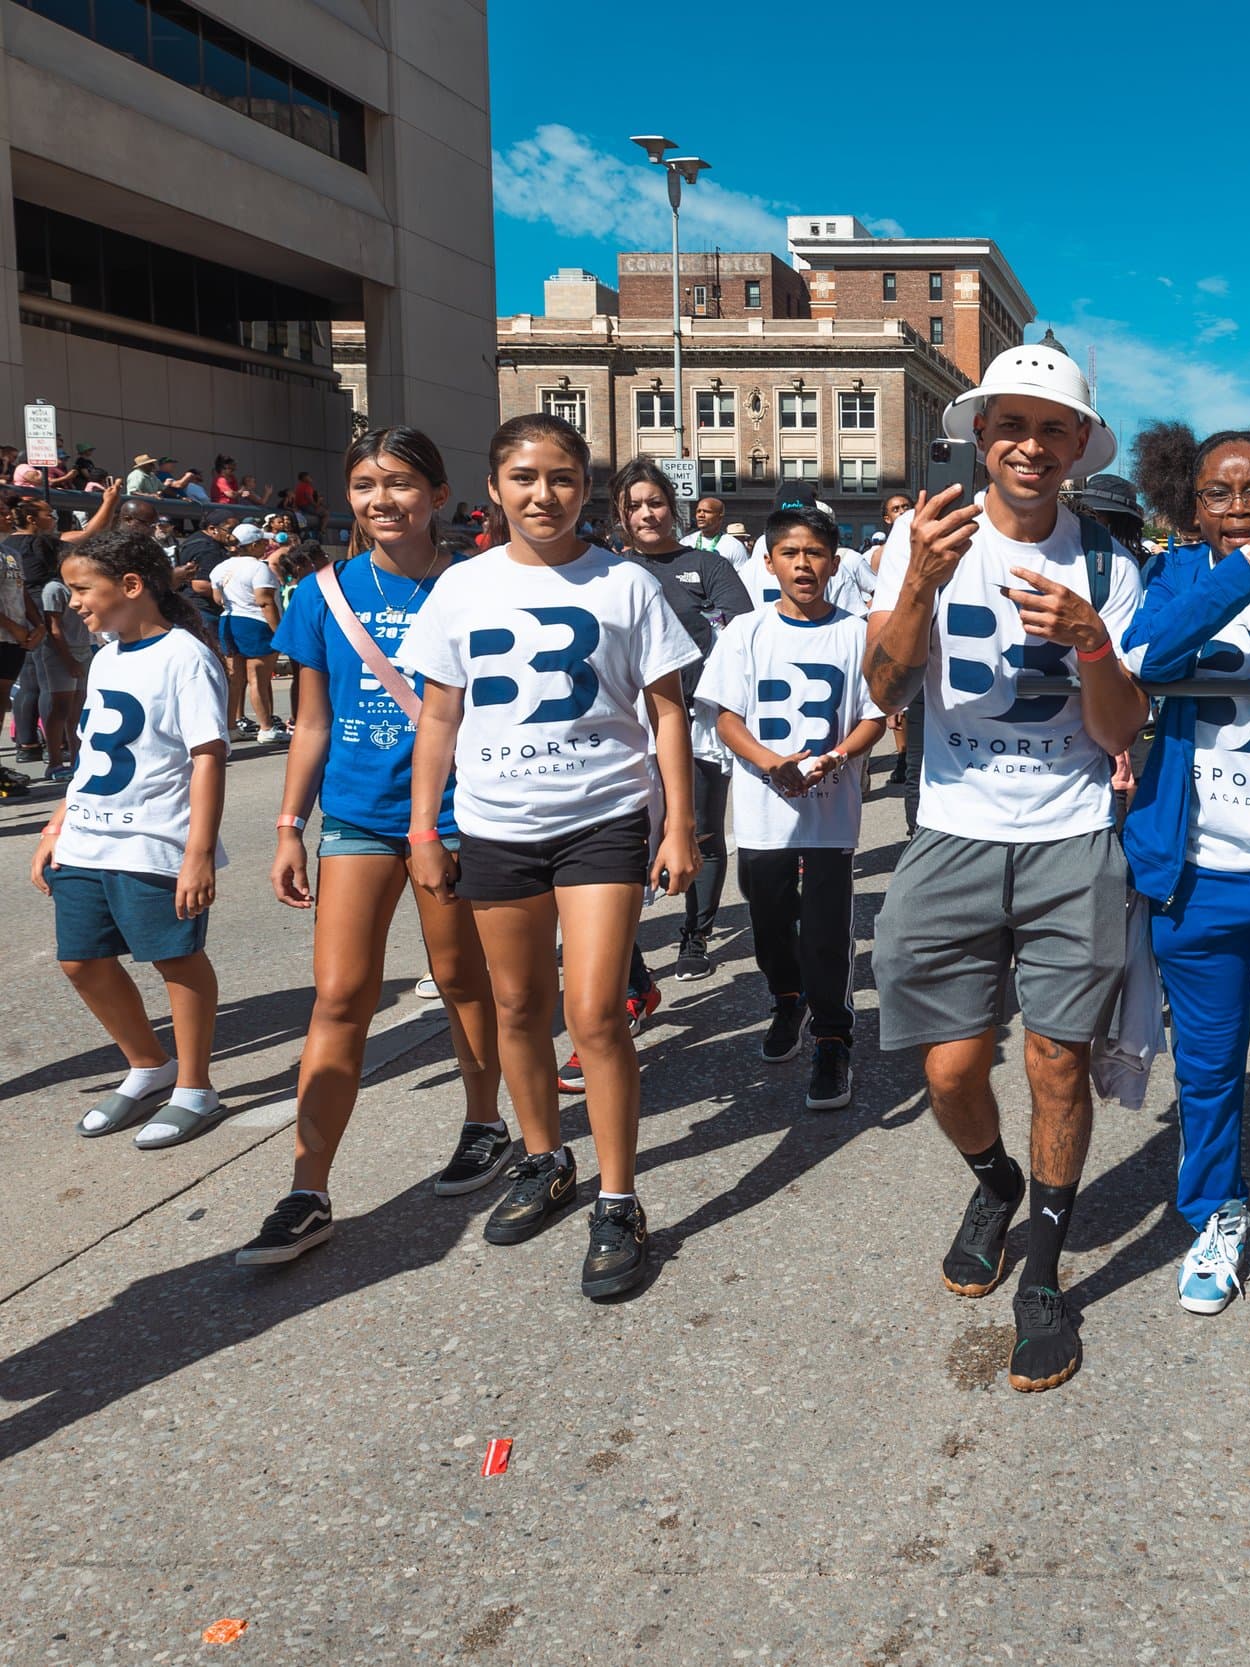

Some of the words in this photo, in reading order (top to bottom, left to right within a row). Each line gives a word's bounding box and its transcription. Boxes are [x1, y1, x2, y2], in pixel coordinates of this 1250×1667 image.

[664, 463, 694, 471] SPEED
[668, 472, 691, 480] LIMIT
[374, 626, 410, 639] 202
[480, 732, 602, 763] SPORTS
[947, 732, 1073, 756] SPORTS
[498, 758, 588, 779] ACADEMY
[965, 761, 1056, 775] ACADEMY
